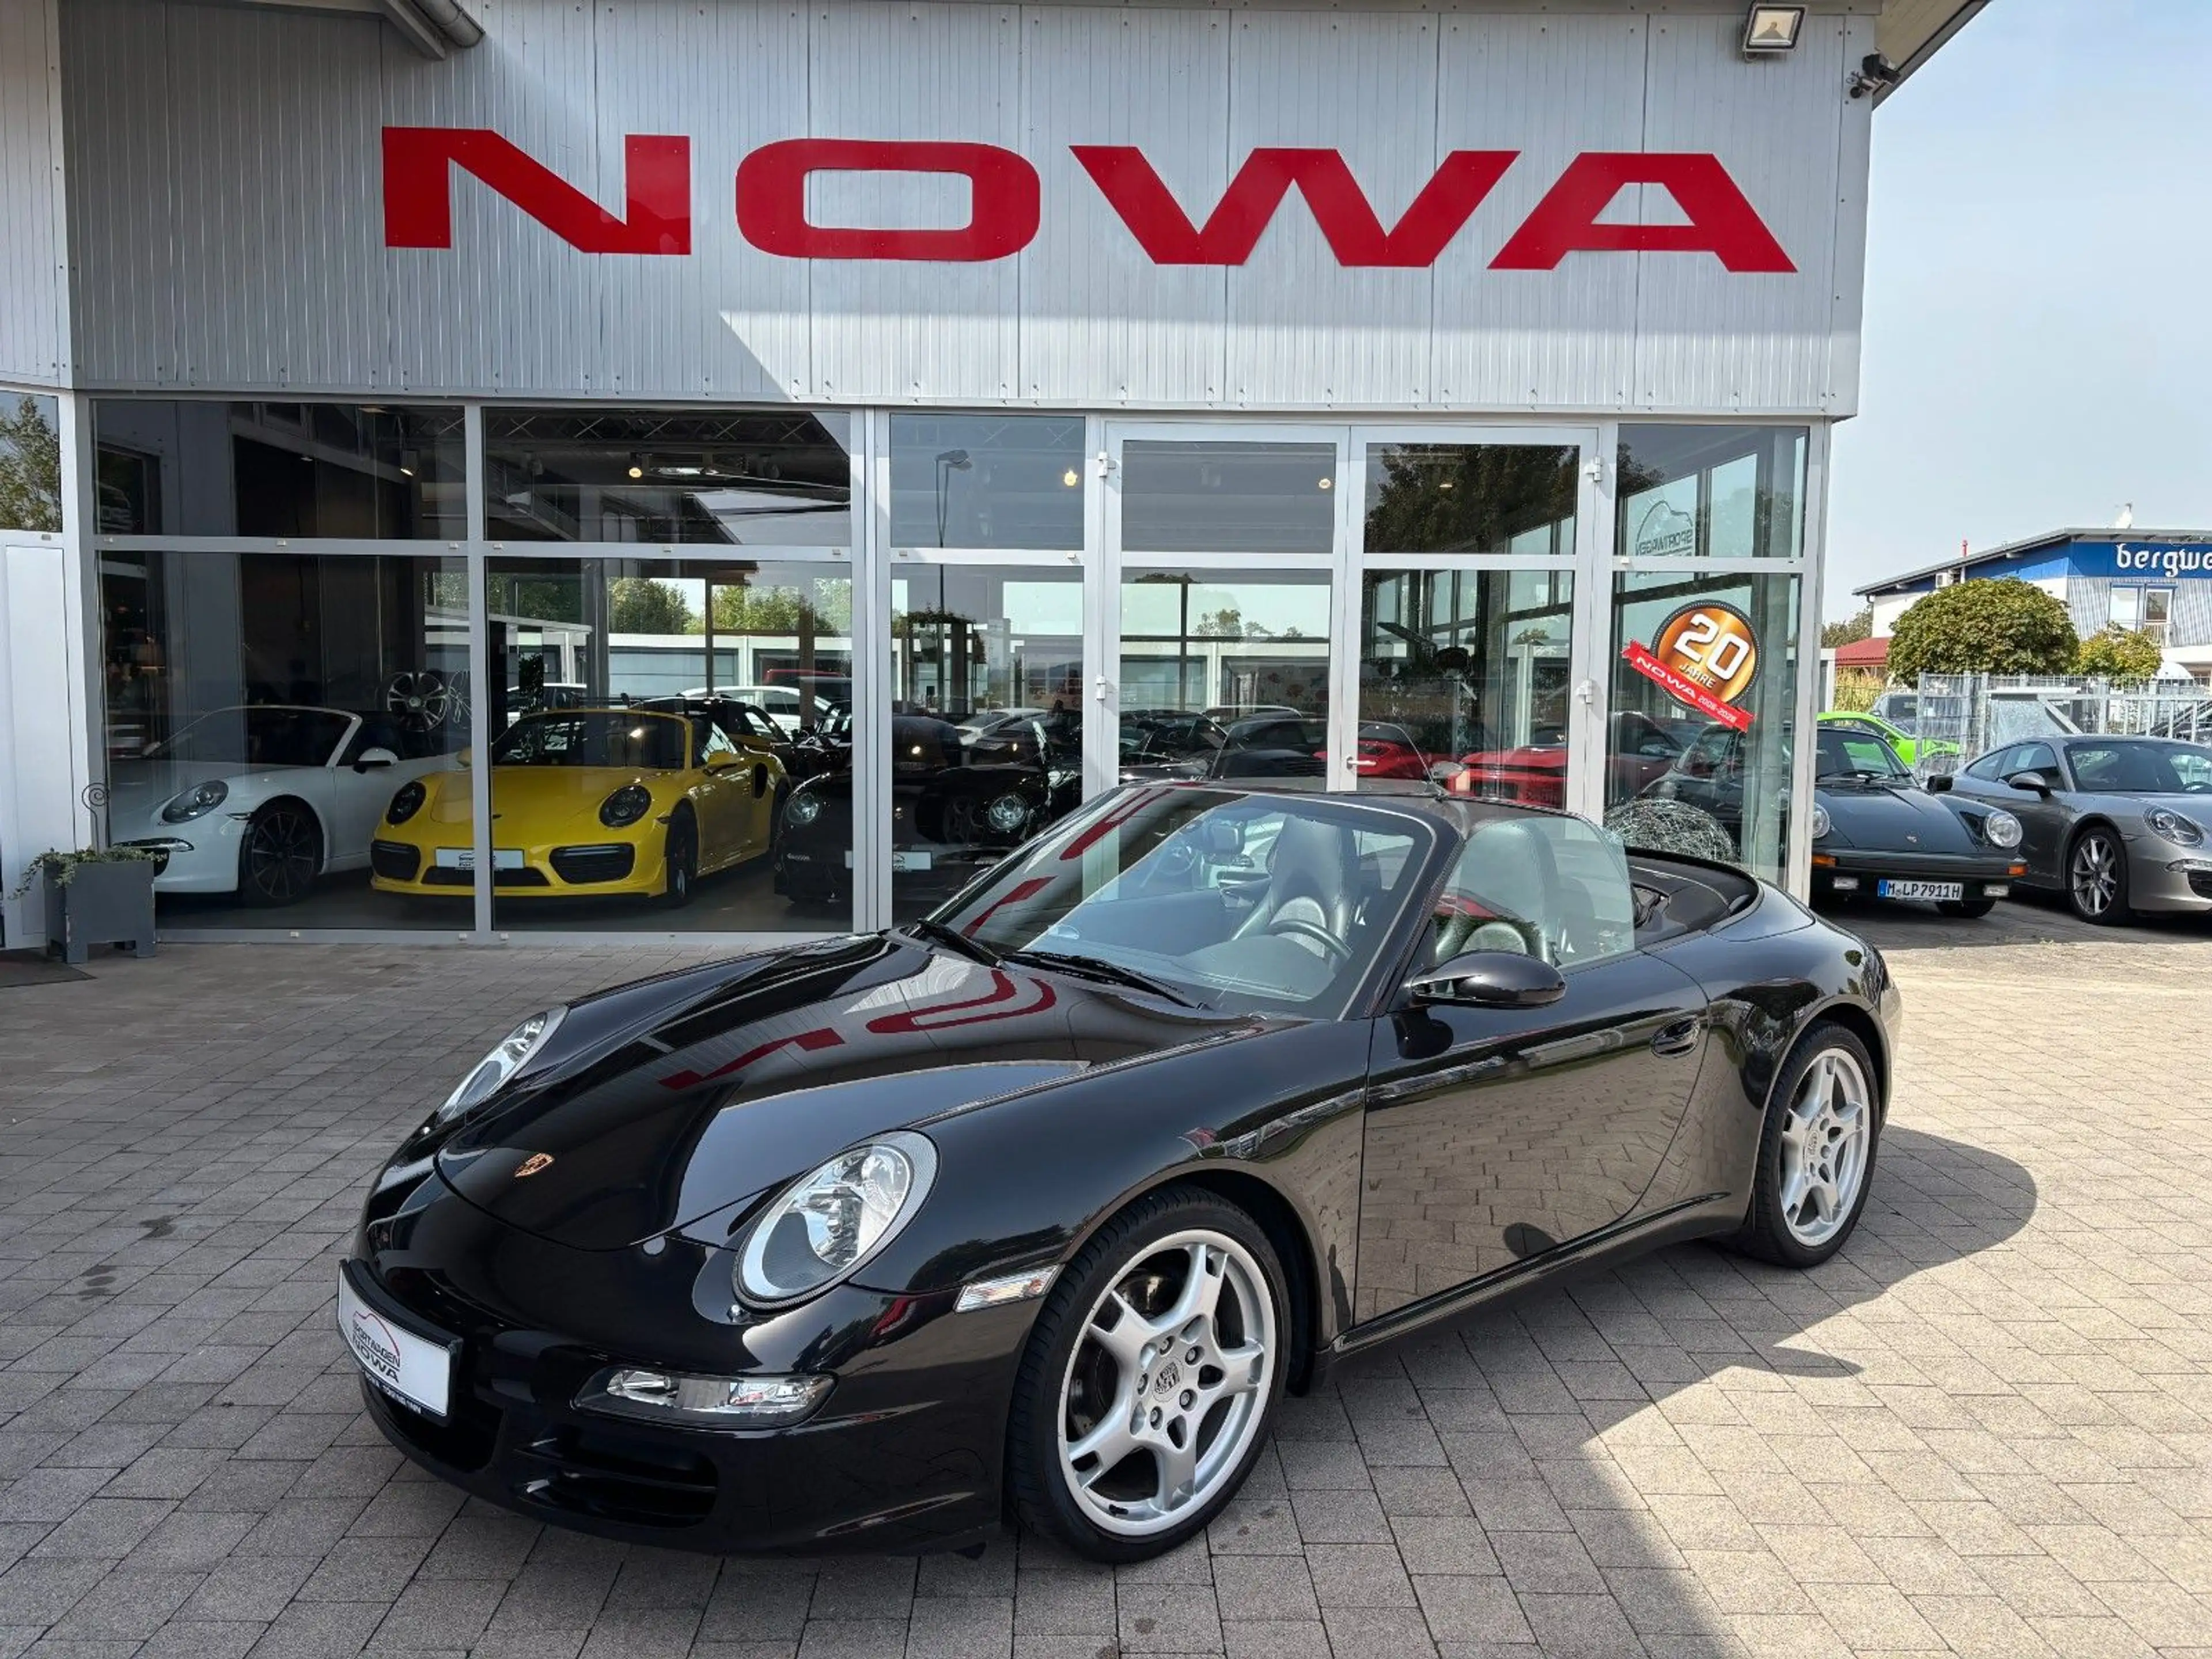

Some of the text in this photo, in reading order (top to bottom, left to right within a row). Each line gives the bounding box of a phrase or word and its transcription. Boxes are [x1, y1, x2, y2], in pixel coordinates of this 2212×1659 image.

[382, 126, 1798, 273] NOWA
[1674, 613, 1750, 680] 20
[1637, 656, 1696, 699] NOWA
[1679, 663, 1717, 689] JAHRE
[353, 1334, 399, 1383] NOWA
